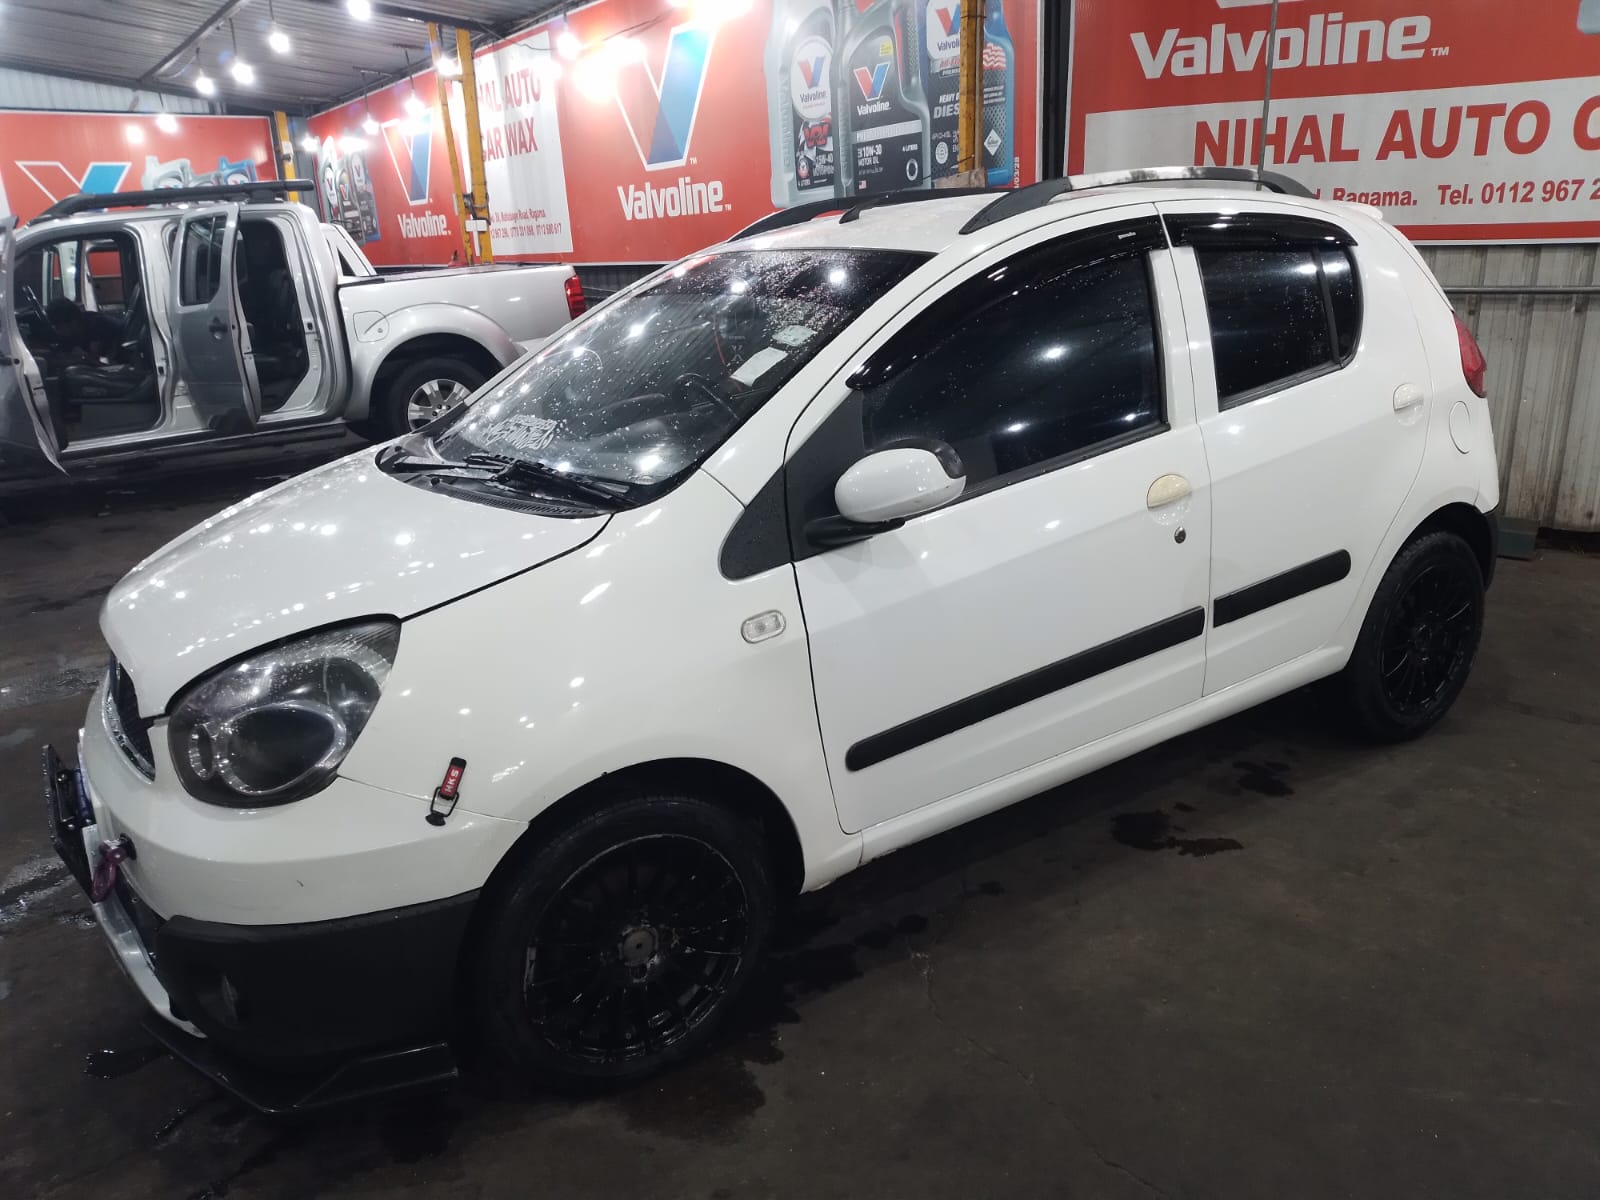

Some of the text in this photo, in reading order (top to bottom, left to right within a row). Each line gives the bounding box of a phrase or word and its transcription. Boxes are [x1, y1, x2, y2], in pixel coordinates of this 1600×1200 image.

[1130, 12, 1431, 79] Valvoline
[857, 101, 890, 116] Valvoline
[504, 117, 538, 157] WAX
[1193, 113, 1360, 167] NIHAL
[1375, 99, 1551, 160] AUTO
[617, 176, 724, 221] Valvoline
[1438, 183, 1474, 205] Tel.
[1481, 181, 1535, 205] 0112
[1541, 179, 1585, 203] 967
[397, 210, 447, 239] Valvoline
[445, 769, 459, 793] HKS
